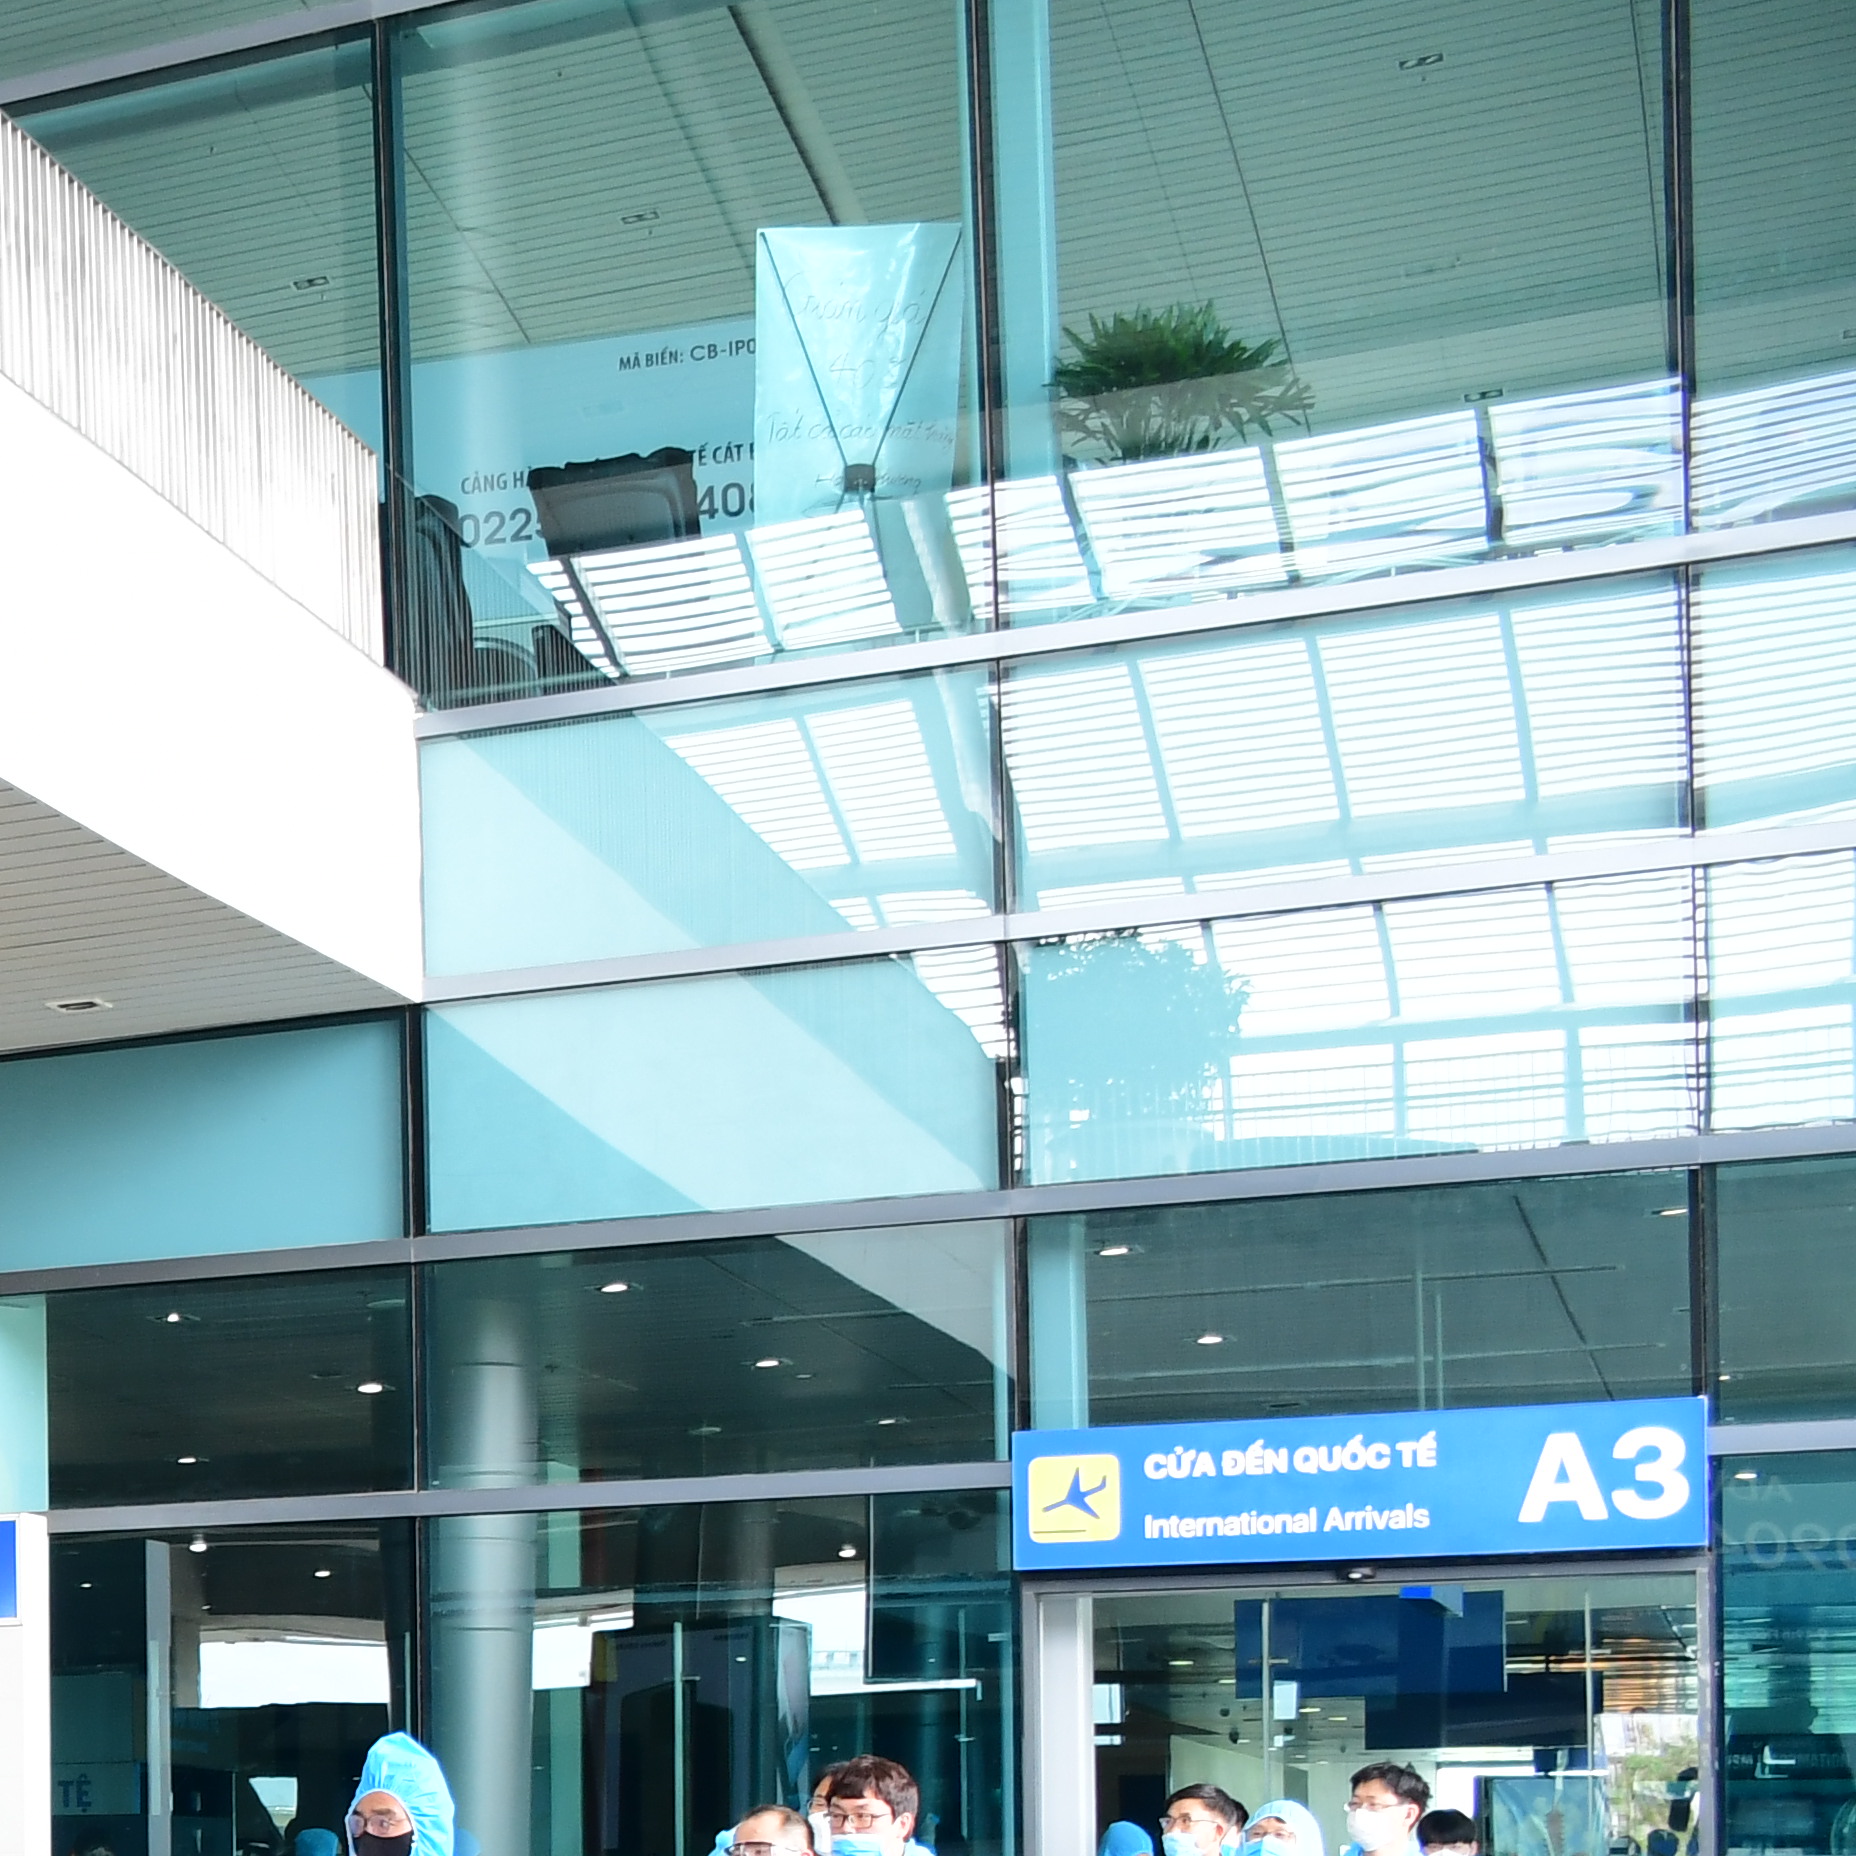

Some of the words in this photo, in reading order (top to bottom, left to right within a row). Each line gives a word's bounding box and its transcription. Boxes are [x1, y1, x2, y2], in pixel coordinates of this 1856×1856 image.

[698, 481, 756, 520] 40
[1142, 1443, 1217, 1480] CỬA
[1221, 1438, 1289, 1478] ĐẾN
[1293, 1434, 1393, 1476] QUỐC
[1397, 1430, 1438, 1469] TẾ
[1516, 1424, 1692, 1524] A3
[1144, 1508, 1318, 1540] International
[1323, 1503, 1431, 1535] Arrivals
